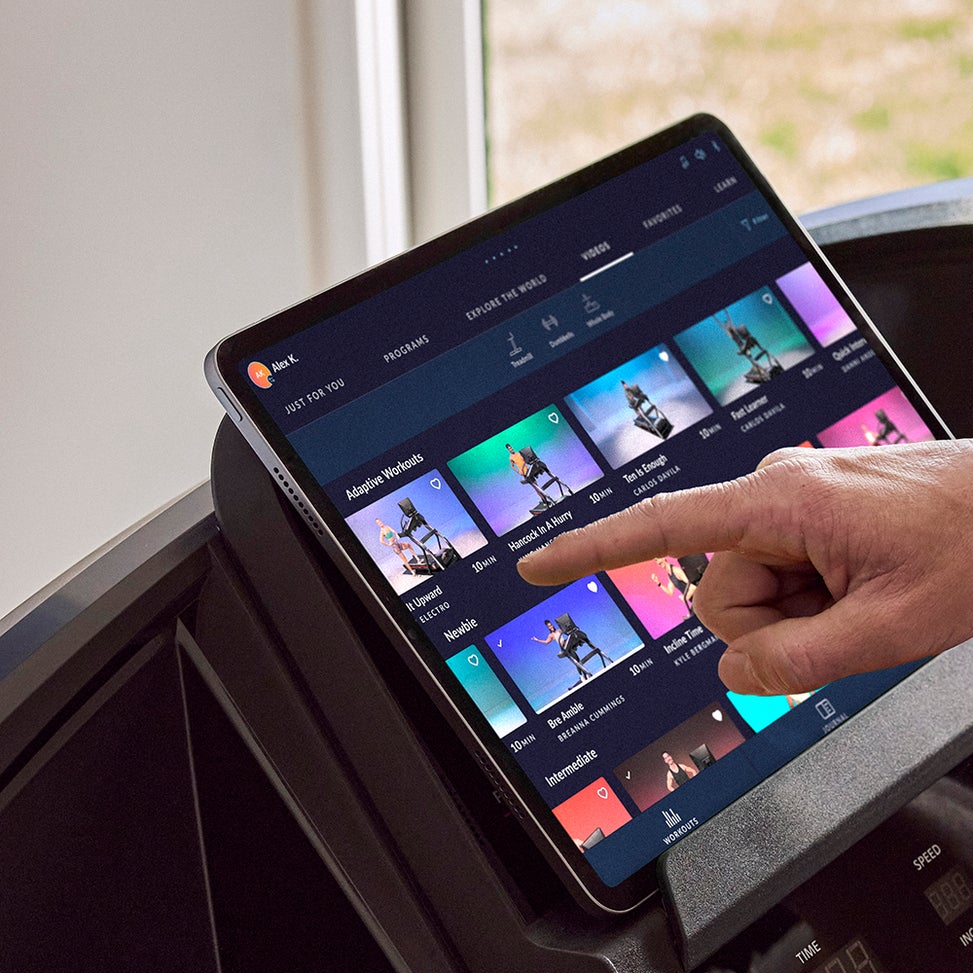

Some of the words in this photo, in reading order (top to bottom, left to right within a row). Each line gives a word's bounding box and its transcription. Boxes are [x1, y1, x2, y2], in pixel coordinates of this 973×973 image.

[643, 204, 682, 229] FAVORITES
[580, 241, 611, 261] VIDEOS
[465, 297, 502, 321] EXPLORE
[500, 288, 519, 303] THE
[517, 274, 548, 294] WORLD
[383, 334, 430, 363] PROGRAMS
[271, 359, 290, 373] Alex
[287, 354, 299, 364] K.
[284, 398, 306, 415] JUST
[306, 388, 326, 403] FOR
[325, 378, 345, 393] YOU
[730, 408, 747, 421] Fast
[740, 415, 765, 433] CARLOS
[345, 473, 385, 501] Adaptive
[381, 452, 424, 480] Workouts
[623, 473, 638, 484] Ten
[636, 468, 644, 477] Is
[641, 453, 669, 473] Enough
[632, 478, 659, 497] CARLOS
[657, 465, 681, 483] DAVILA
[507, 529, 540, 552] Hancock
[538, 525, 547, 535] In
[546, 521, 554, 530] A
[552, 510, 573, 526] Hurry
[405, 601, 416, 612] It
[413, 584, 444, 611] Upward
[419, 601, 451, 624] ELECTRO
[443, 618, 478, 643] Newbie
[663, 636, 688, 655] Incline
[684, 625, 704, 640] Time
[673, 652, 691, 667] KYLE
[547, 716, 563, 730] Bre
[560, 702, 585, 721] Amble
[557, 719, 590, 743] BREANNA
[589, 695, 626, 722] CUMMINGS
[545, 749, 598, 787] Intermediate
[663, 817, 700, 845] WORKOUTS
[913, 844, 942, 871] SPEED
[795, 940, 821, 965] TIME
